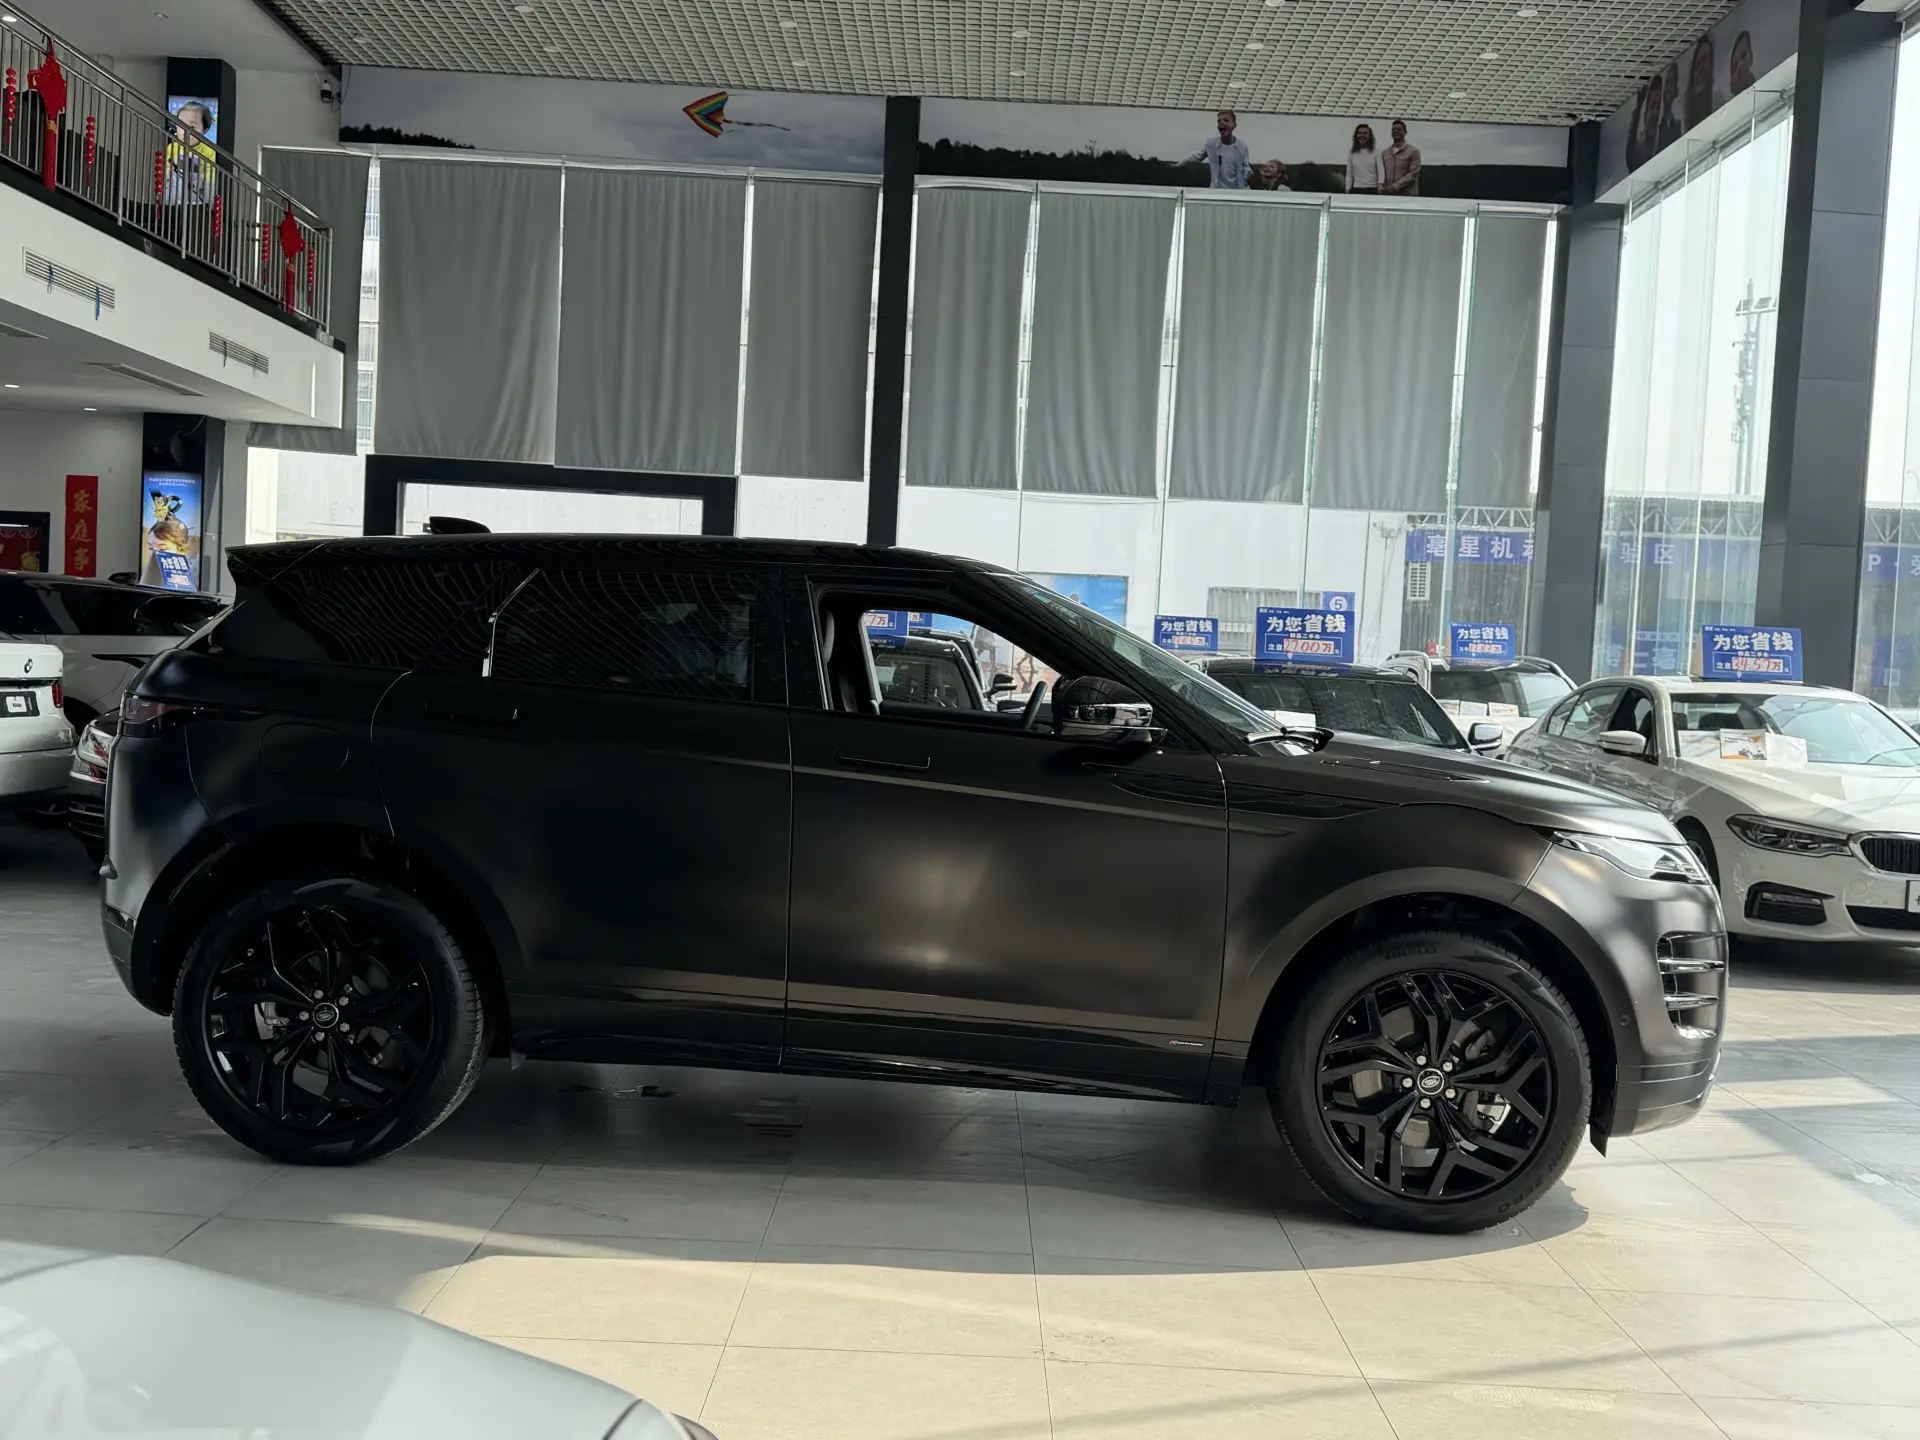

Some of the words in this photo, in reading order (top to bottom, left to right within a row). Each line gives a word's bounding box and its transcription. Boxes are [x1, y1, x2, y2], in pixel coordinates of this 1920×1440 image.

[1333, 598, 1343, 611] 5
[1161, 620, 1213, 632] 为您省钱
[1266, 614, 1346, 633] 为您省钱
[1457, 627, 1509, 640] 为您省钱
[1713, 632, 1794, 651] 为您省钱
